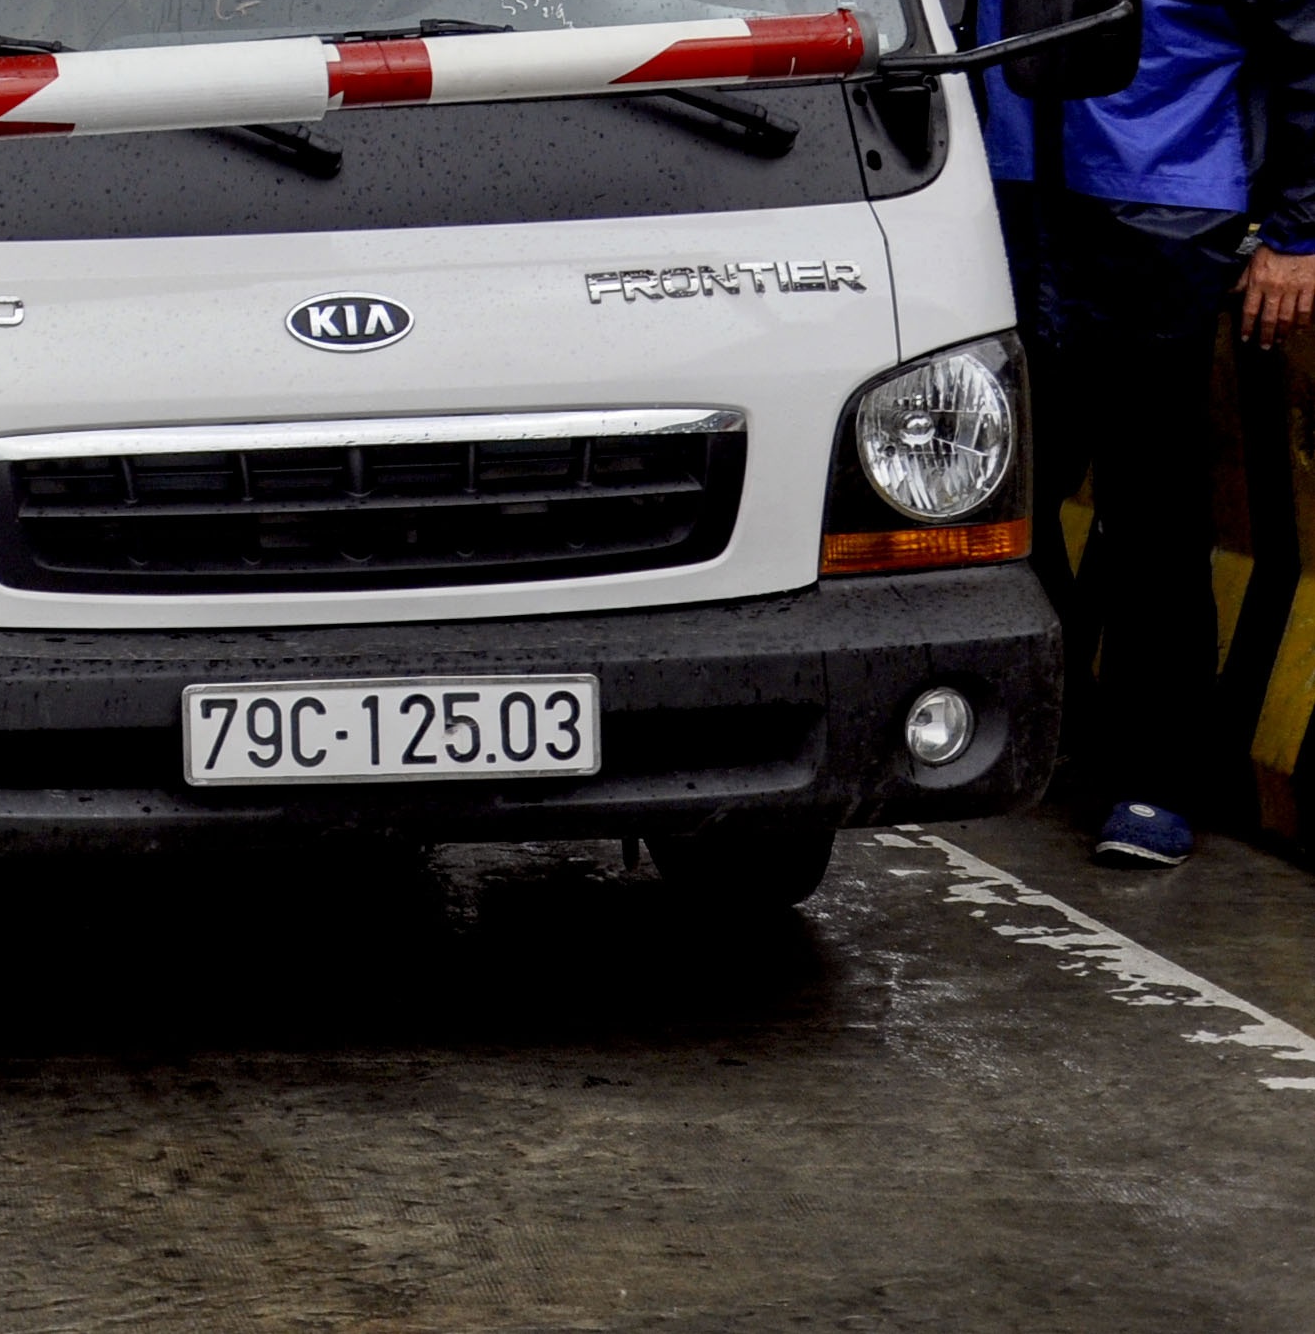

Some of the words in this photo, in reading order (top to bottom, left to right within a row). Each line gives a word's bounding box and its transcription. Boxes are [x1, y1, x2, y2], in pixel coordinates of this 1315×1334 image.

[585, 260, 867, 306] FRONTIER
[308, 304, 393, 338] KIA
[199, 689, 582, 771] 79C-125.03
